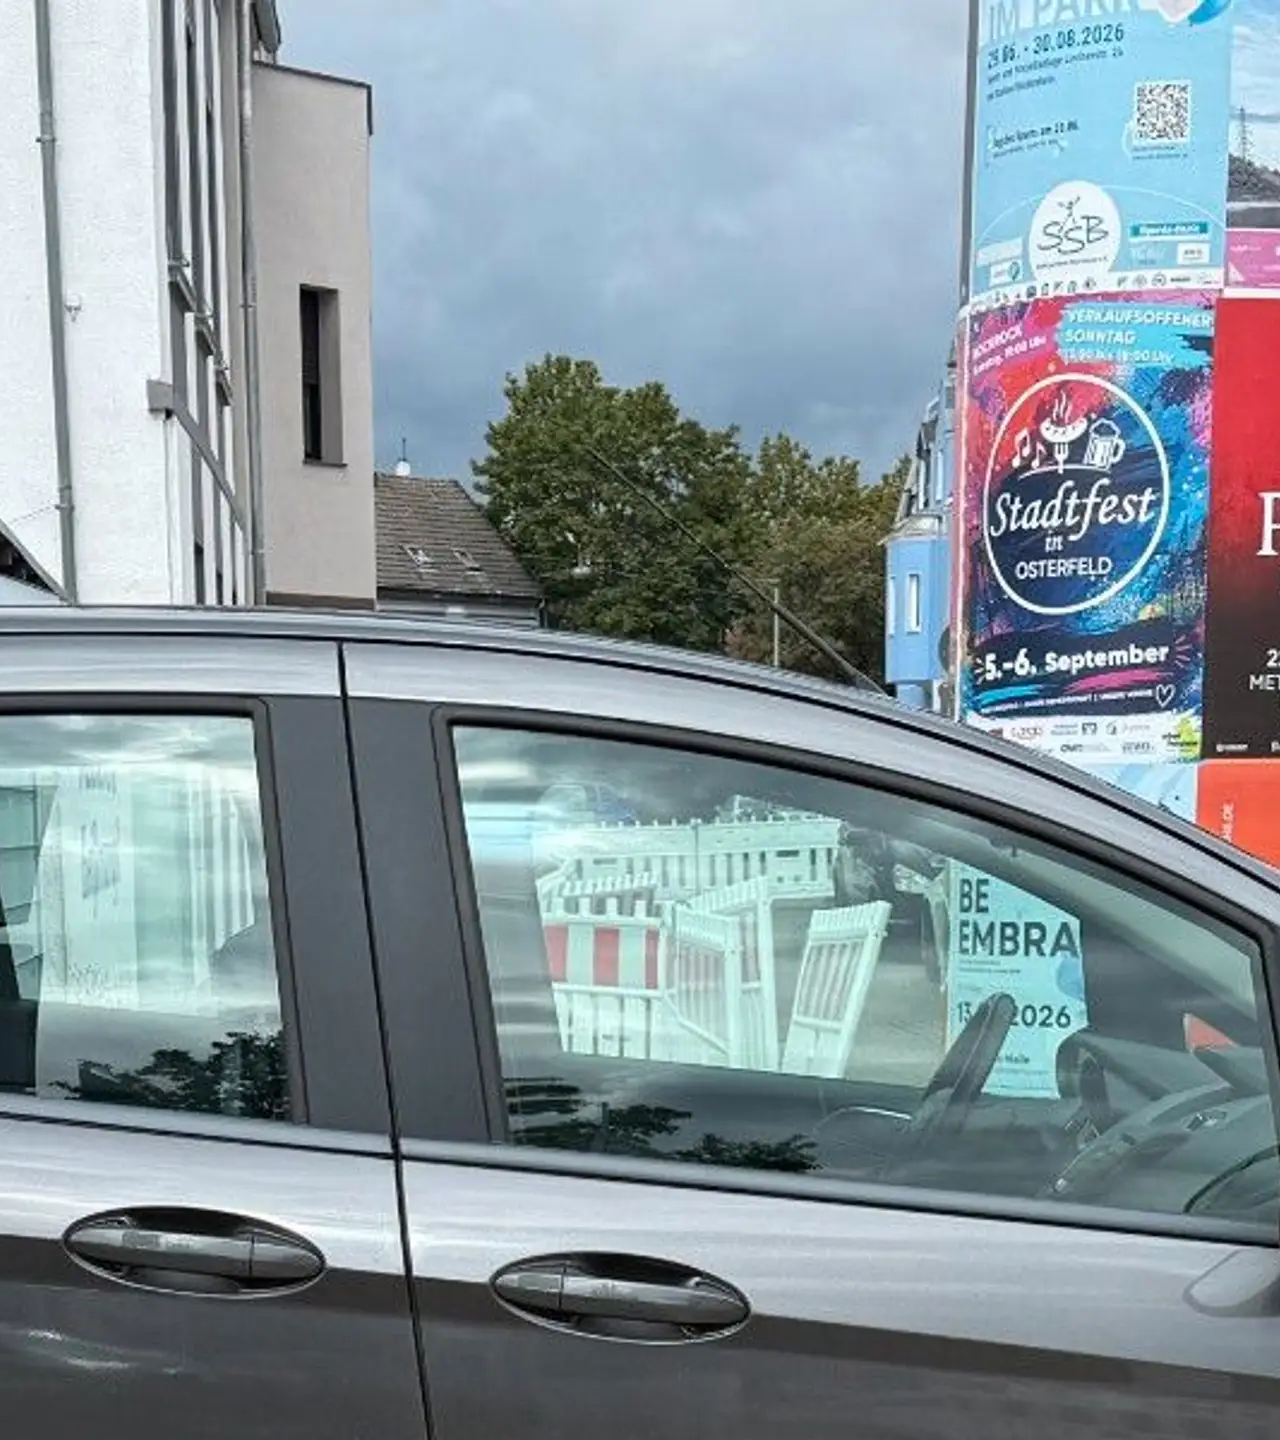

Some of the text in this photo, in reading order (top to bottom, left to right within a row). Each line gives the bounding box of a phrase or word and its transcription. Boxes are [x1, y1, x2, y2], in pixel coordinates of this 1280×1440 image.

[1036, 215, 1110, 256] SSB
[1064, 329, 1136, 345] SONNTAG
[990, 478, 1156, 542] Stadtfest
[1045, 529, 1063, 552] in
[1015, 556, 1112, 580] OSTERFELD
[1045, 644, 1169, 674] September
[959, 878, 989, 913] BE
[958, 919, 1080, 957] EMBRA
